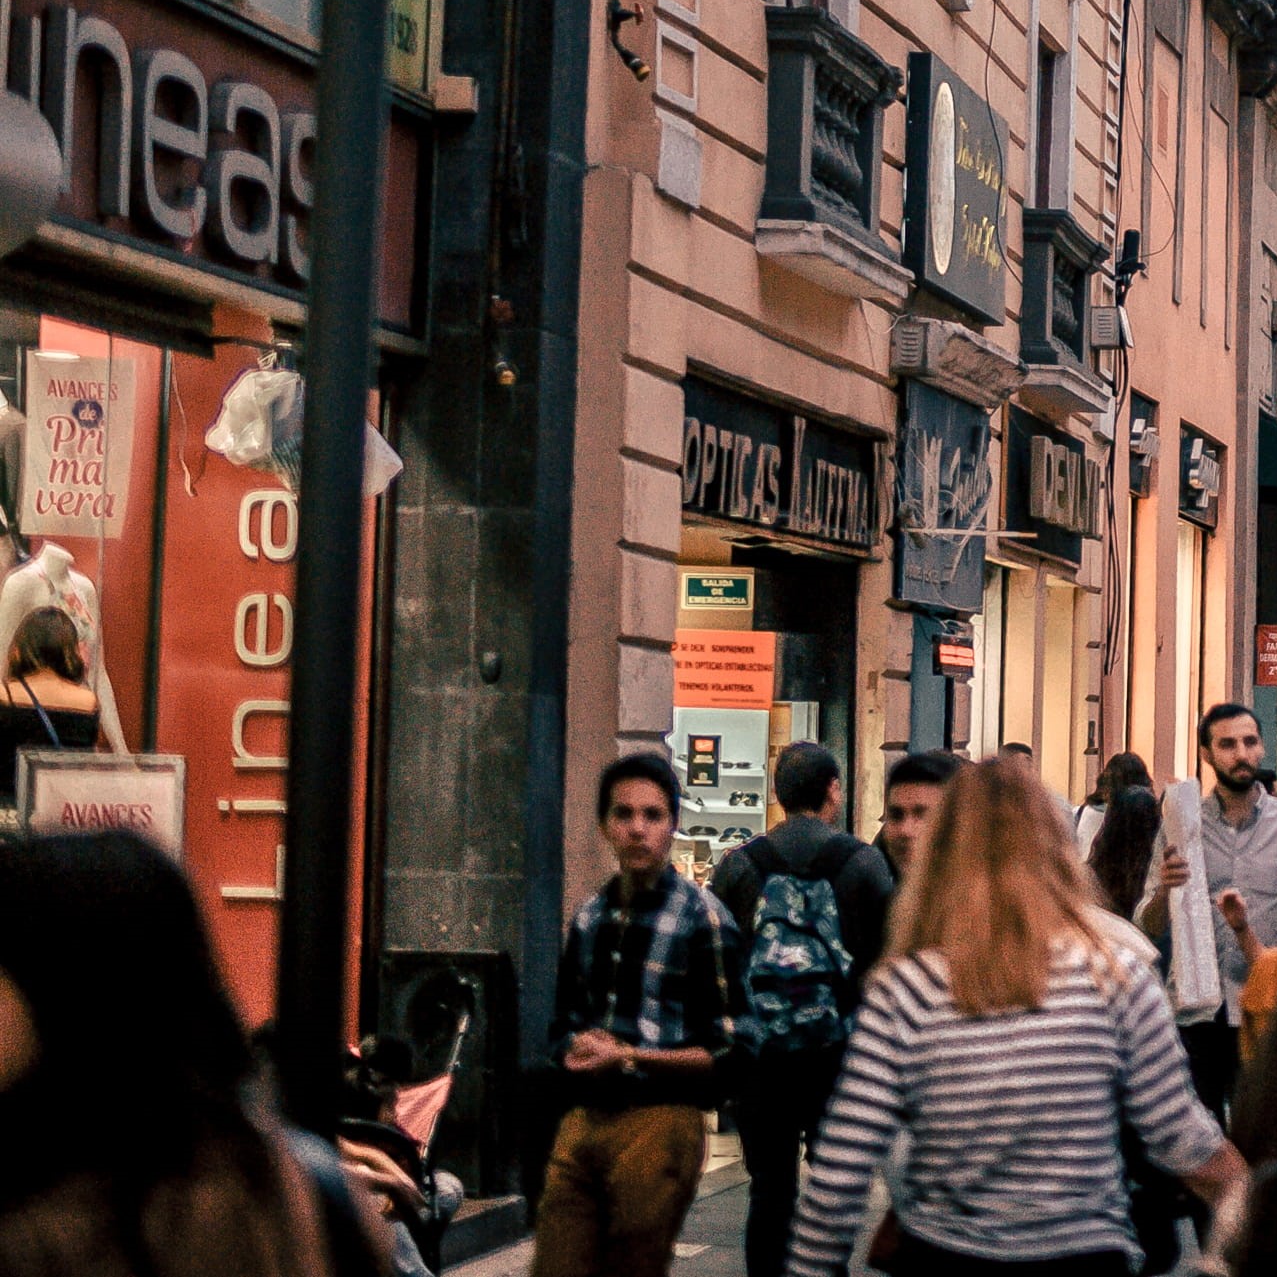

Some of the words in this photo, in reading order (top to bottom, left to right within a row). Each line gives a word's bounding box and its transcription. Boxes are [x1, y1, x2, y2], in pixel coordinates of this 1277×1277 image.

[47, 379, 119, 401] AVANCES
[78, 403, 98, 421] de
[46, 415, 105, 455] Pri
[49, 456, 103, 486] ma
[683, 416, 781, 525] OPTICAS
[36, 488, 116, 518] vera
[701, 579, 734, 587] SALIDA
[689, 596, 746, 604] EMERGENCIA
[61, 802, 153, 829] AVANCES
